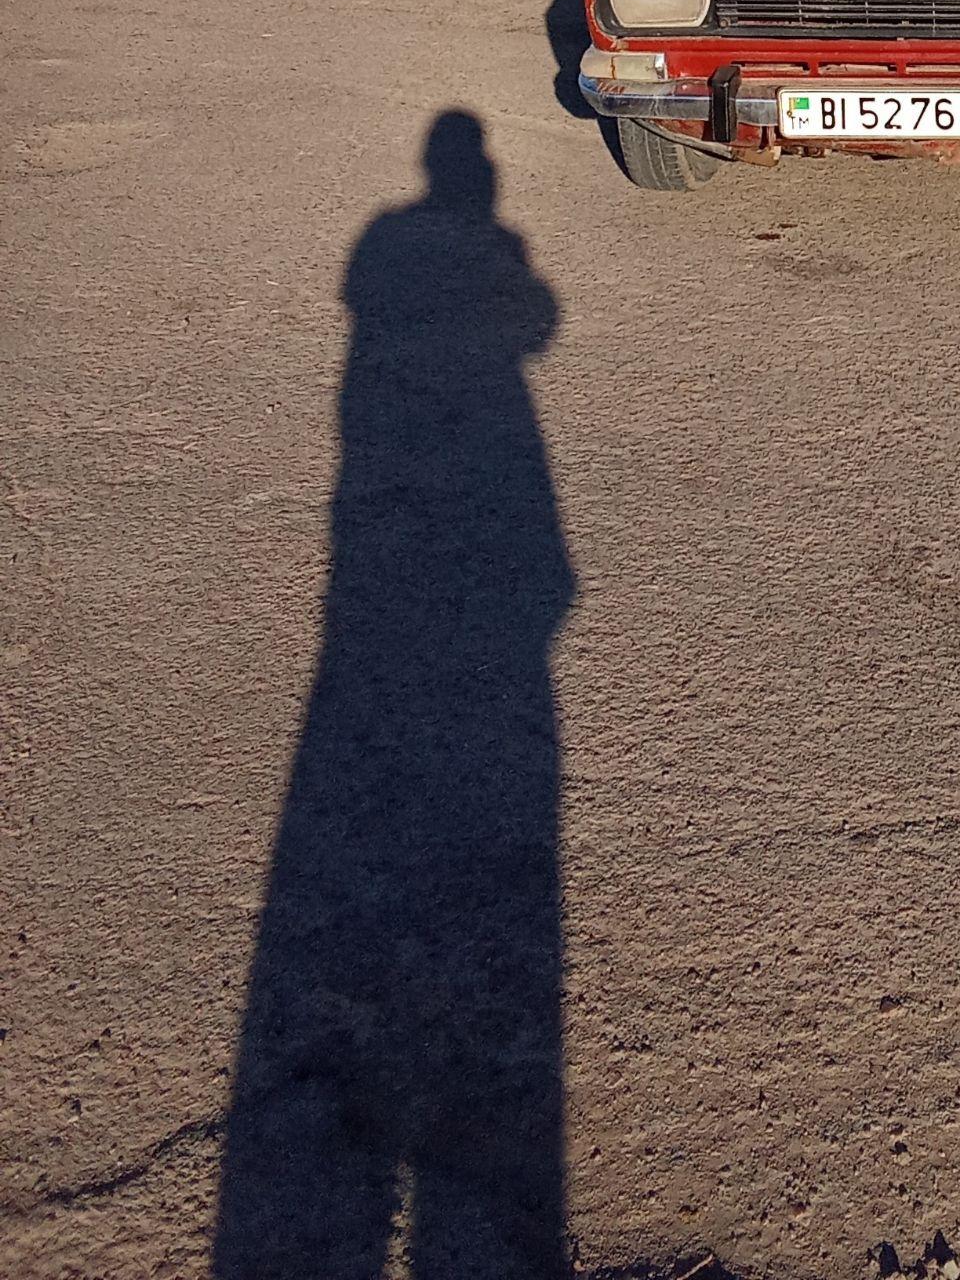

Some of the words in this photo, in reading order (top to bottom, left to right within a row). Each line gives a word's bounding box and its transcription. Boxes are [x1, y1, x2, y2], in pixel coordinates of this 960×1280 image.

[790, 116, 809, 130] TM
[820, 97, 846, 130] BI
[859, 97, 955, 131] 5276
